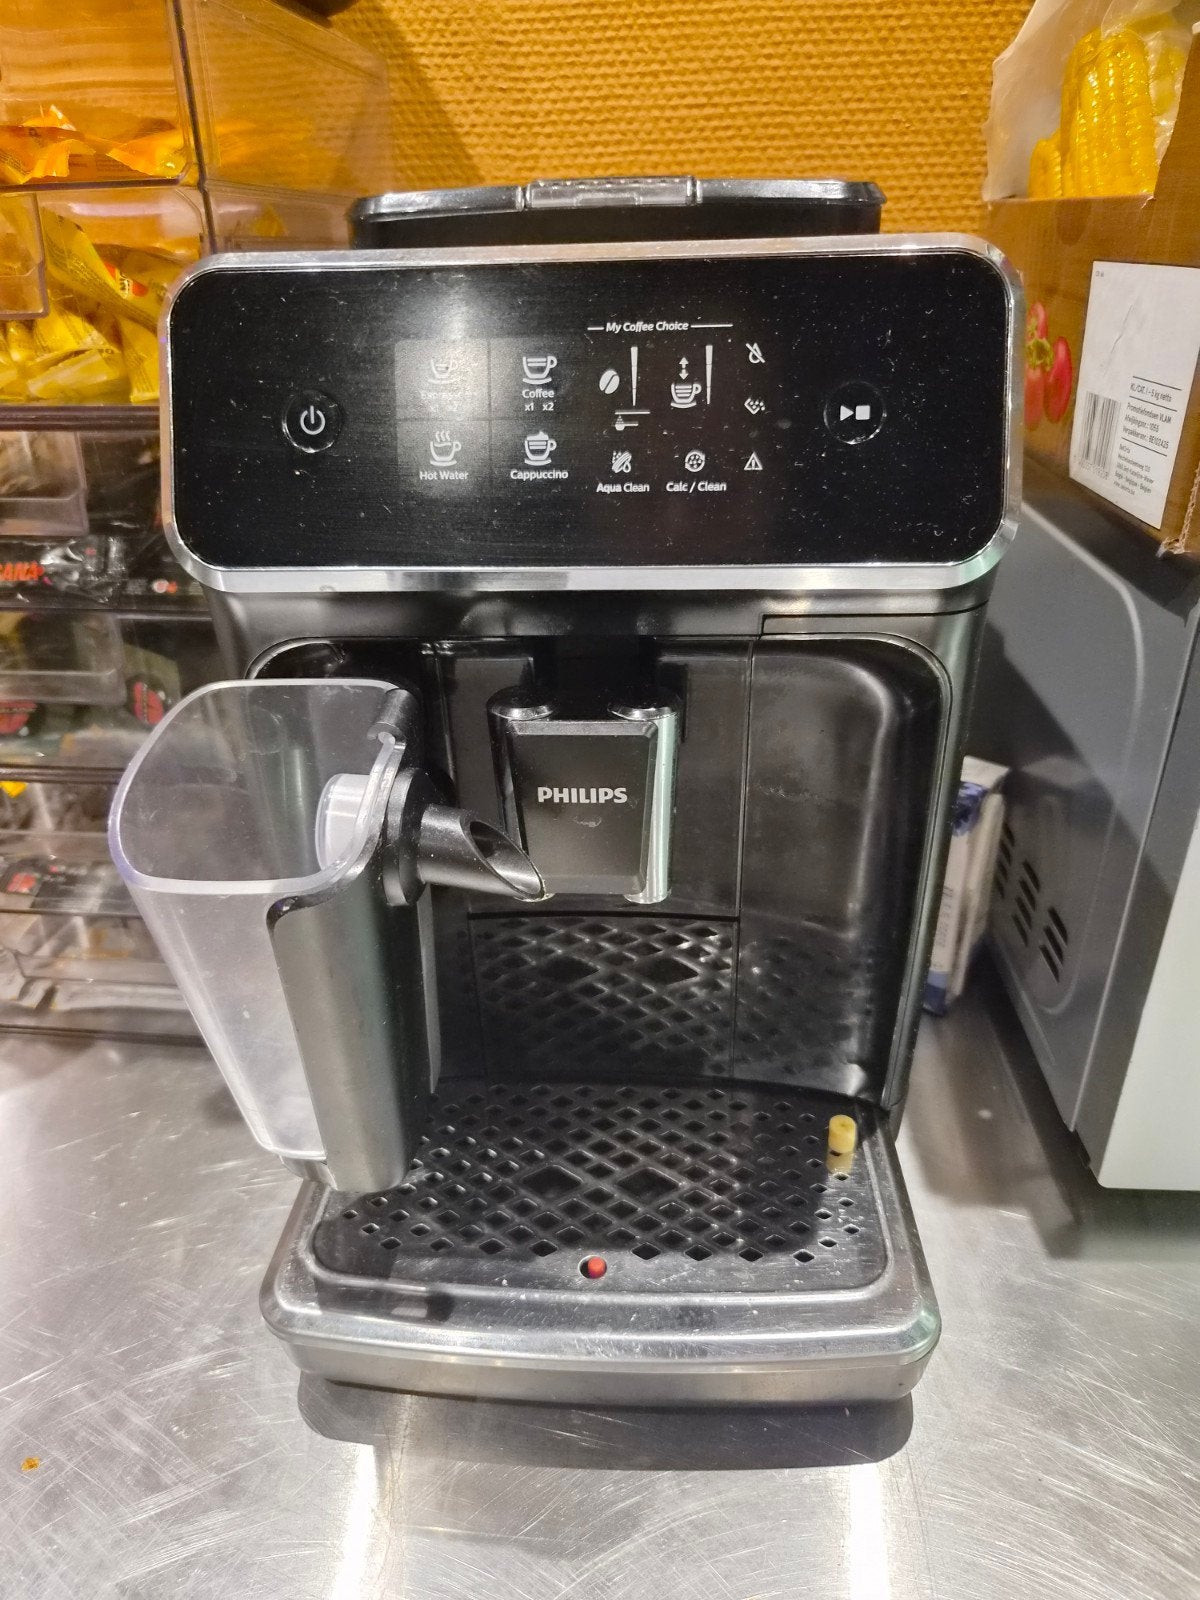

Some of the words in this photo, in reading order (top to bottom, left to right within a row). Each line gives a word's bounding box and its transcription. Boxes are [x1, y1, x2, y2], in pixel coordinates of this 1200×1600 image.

[605, 322, 622, 334] My
[623, 320, 654, 332] Coffee
[655, 320, 689, 331] Choice
[521, 388, 555, 399] Coffee
[524, 402, 534, 411] x1
[542, 402, 554, 411] x2
[419, 470, 438, 480] Hot
[439, 470, 469, 480] Water
[510, 469, 569, 482] Cappuccino
[596, 482, 622, 494] Aqua
[623, 481, 650, 493] Clean
[665, 480, 688, 492] Calc
[689, 481, 696, 493] /
[697, 480, 727, 492] Clean
[537, 786, 628, 804] PHILIPS
